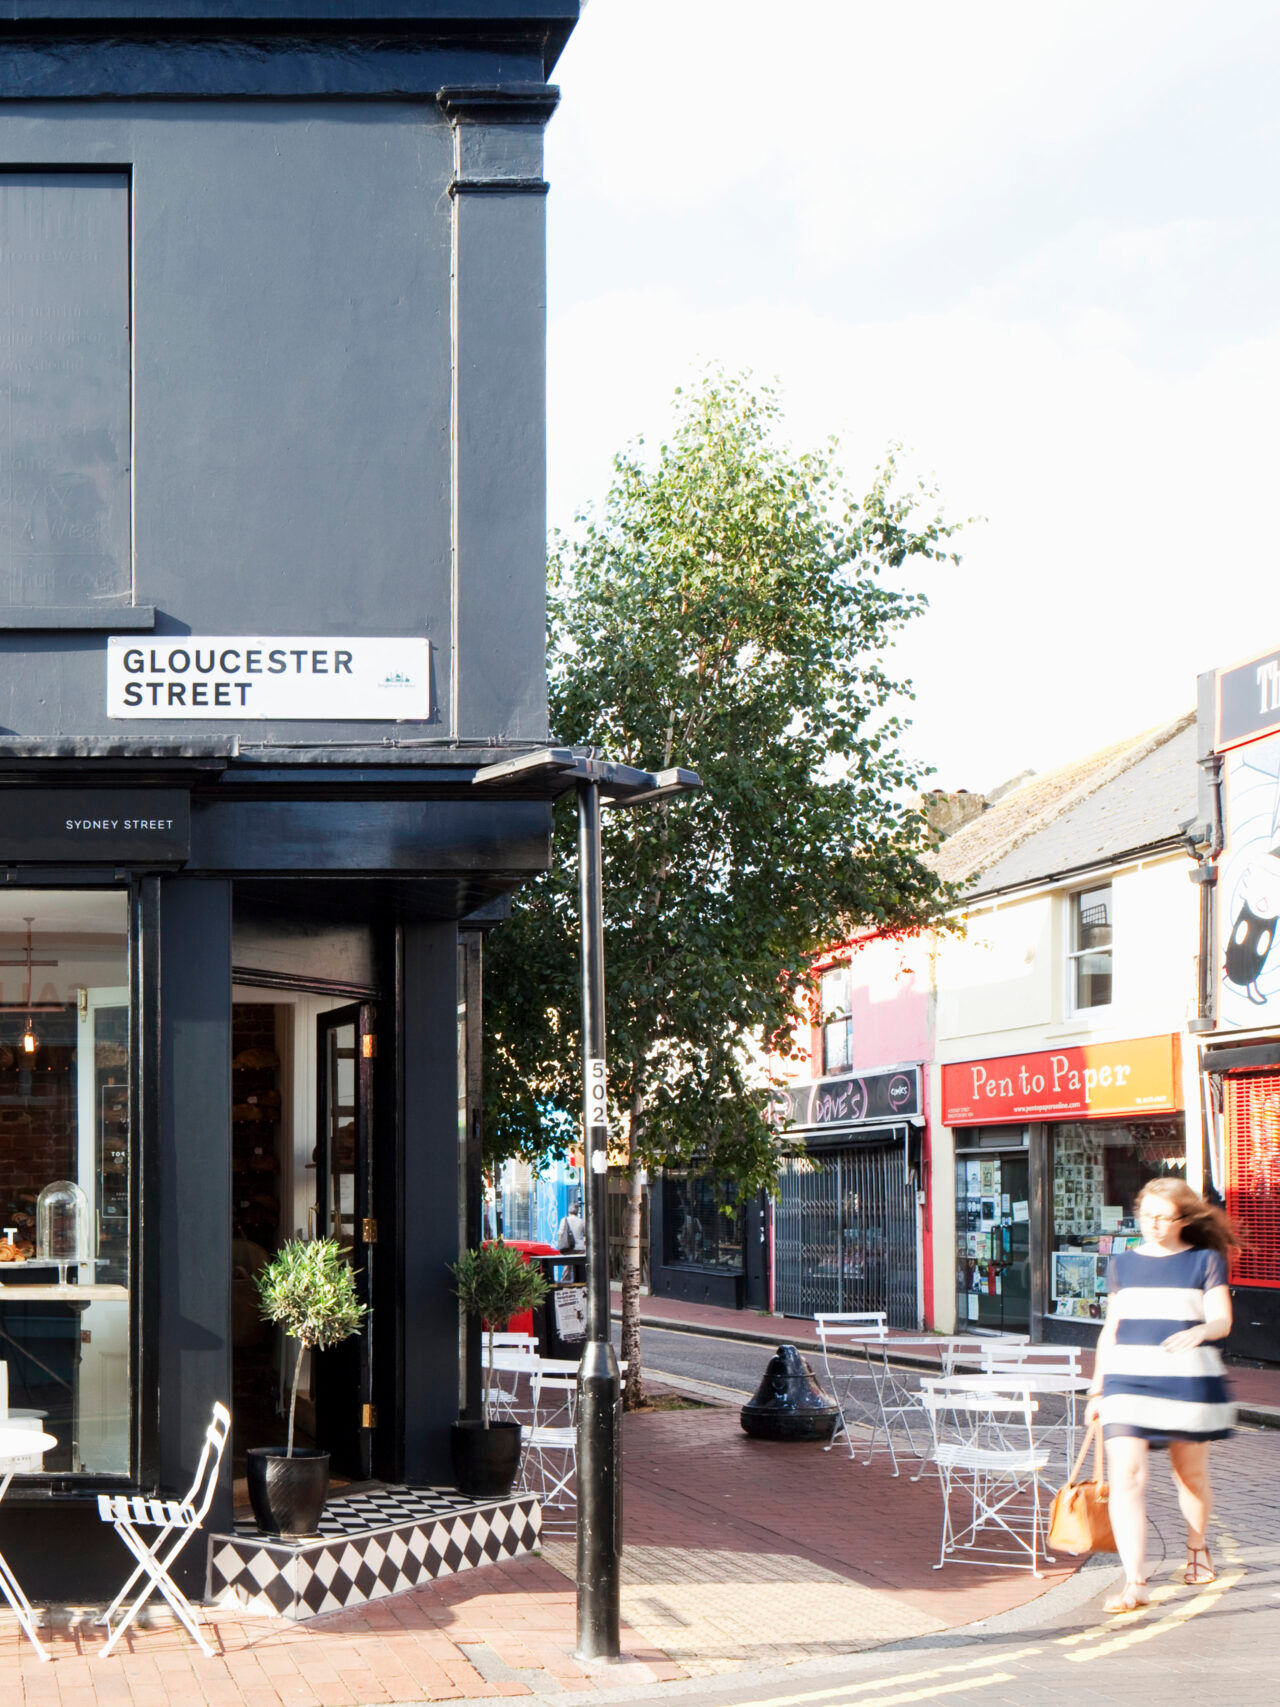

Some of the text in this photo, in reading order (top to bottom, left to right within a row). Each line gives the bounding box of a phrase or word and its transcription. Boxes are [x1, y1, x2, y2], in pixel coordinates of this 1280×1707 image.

[122, 648, 354, 674] GLOUCESTER
[122, 682, 253, 706] STREET
[65, 819, 174, 830] SYDNEY STREET
[970, 1055, 1131, 1103] Pen to Paper
[592, 1062, 605, 1123] 502
